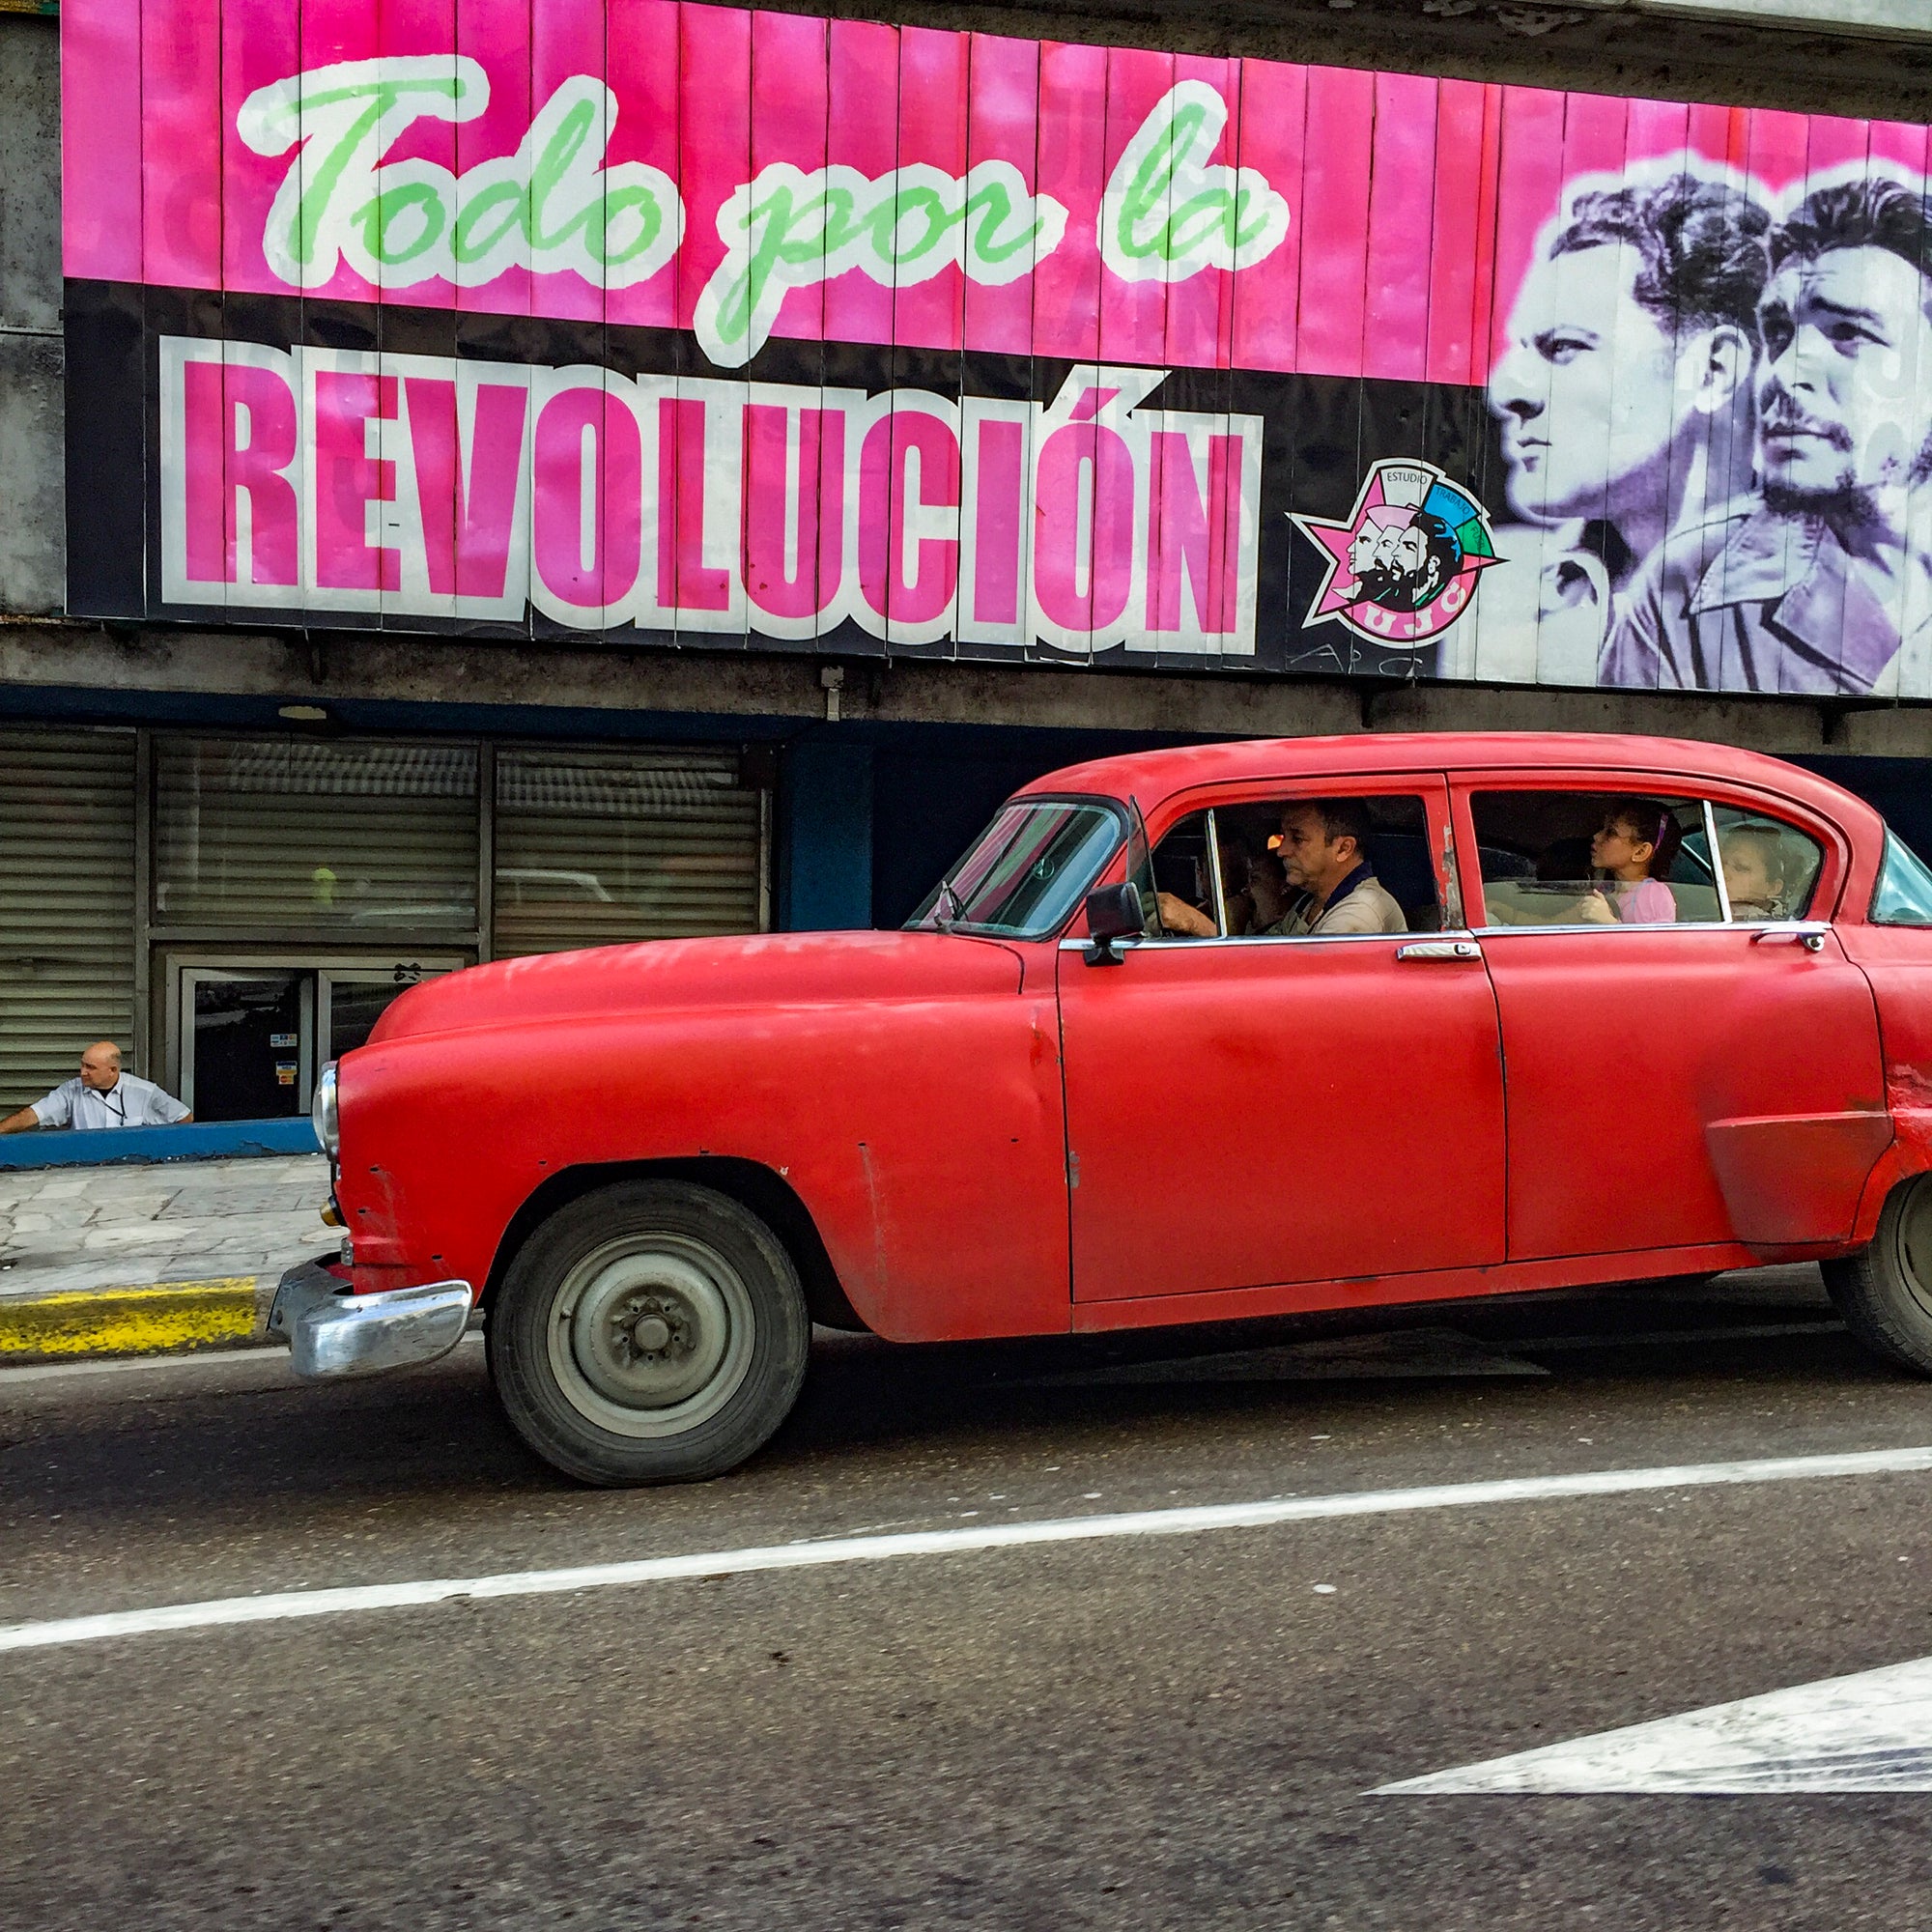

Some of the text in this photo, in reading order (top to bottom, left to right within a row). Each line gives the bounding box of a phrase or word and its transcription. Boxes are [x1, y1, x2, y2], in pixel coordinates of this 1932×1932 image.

[263, 75, 1271, 345] Todo por la
[183, 359, 1244, 635] REVOLUCIÓN
[1387, 471, 1428, 485] ESTUDIO
[1435, 486, 1470, 515] TRABAJO
